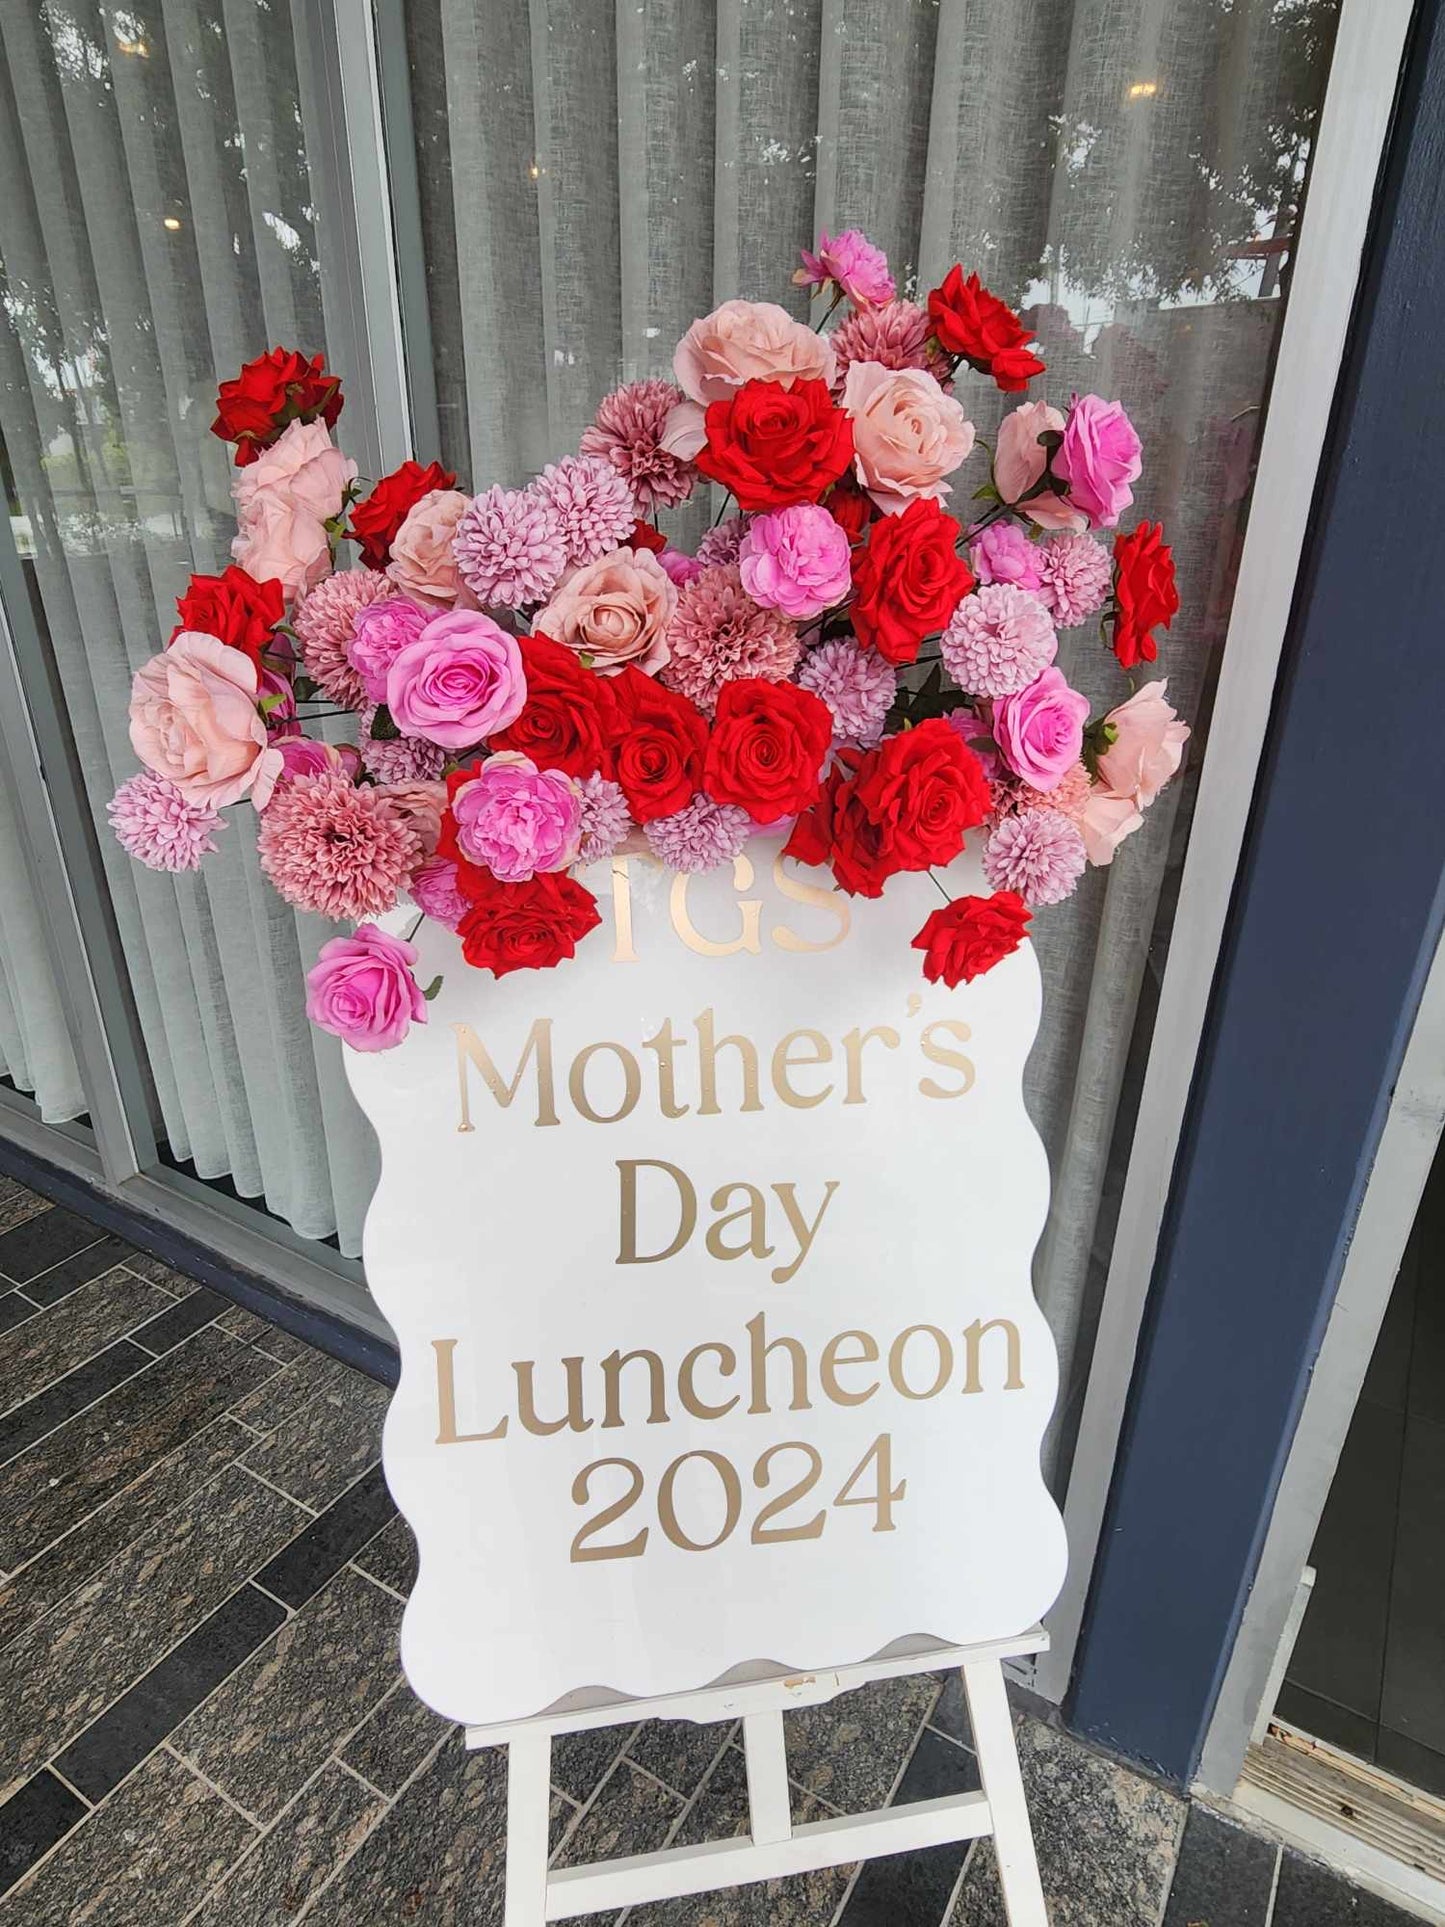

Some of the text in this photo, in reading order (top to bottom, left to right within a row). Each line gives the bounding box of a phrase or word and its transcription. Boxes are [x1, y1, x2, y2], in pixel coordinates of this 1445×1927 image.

[451, 993, 977, 1133] Mother's
[615, 1159, 841, 1284] Day
[431, 1311, 1025, 1445] Luncheon
[570, 1433, 907, 1564] 2024
